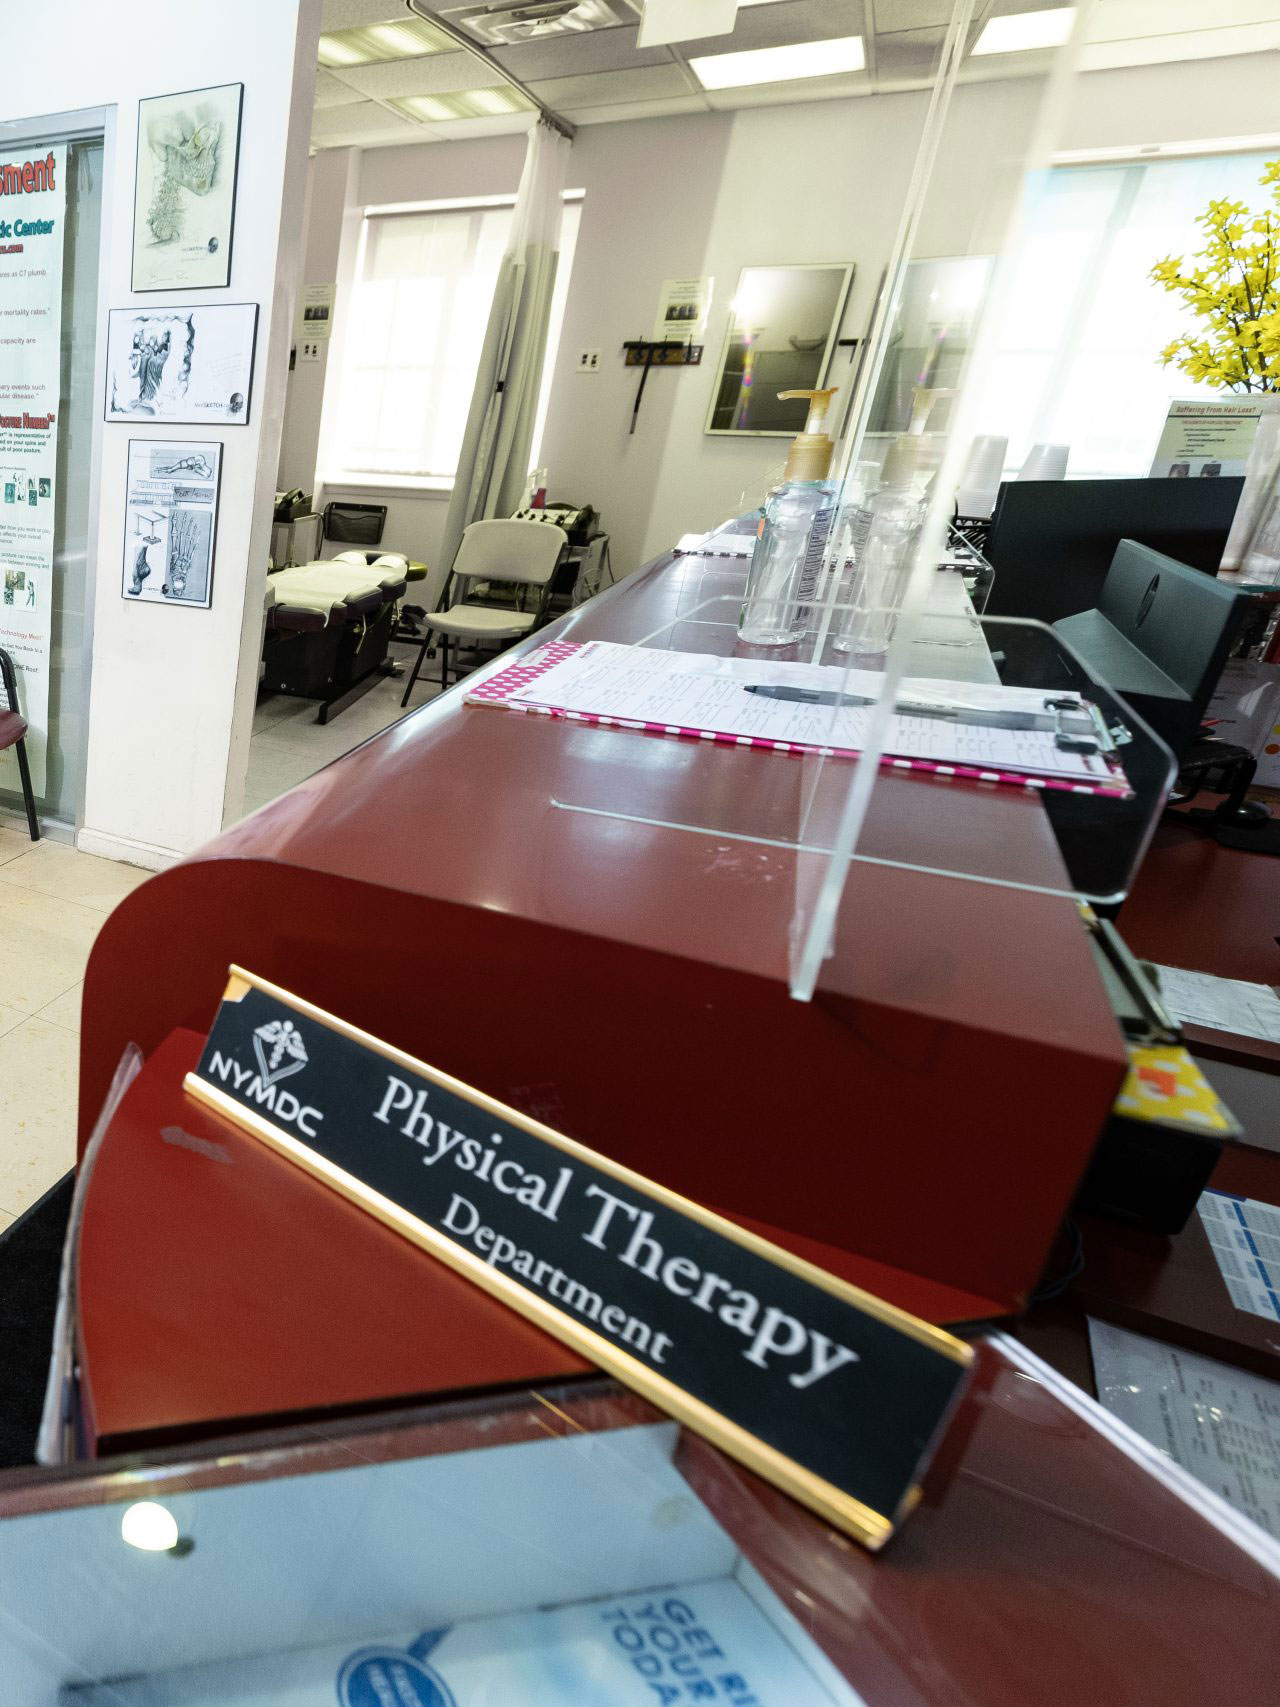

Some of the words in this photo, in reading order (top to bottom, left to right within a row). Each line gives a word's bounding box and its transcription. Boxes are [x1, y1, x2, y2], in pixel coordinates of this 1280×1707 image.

[13, 218, 55, 237] Center
[28, 269, 46, 278] plumb
[4, 309, 29, 317] mortality
[0, 337, 24, 345] capacity
[1175, 406, 1204, 414] Suffering
[209, 1050, 324, 1138] NYMDC
[375, 1074, 573, 1222] Physical
[581, 1183, 861, 1391] Therapy
[440, 1194, 675, 1365] Department
[663, 1599, 726, 1660] GET
[634, 1602, 717, 1700] YOUR
